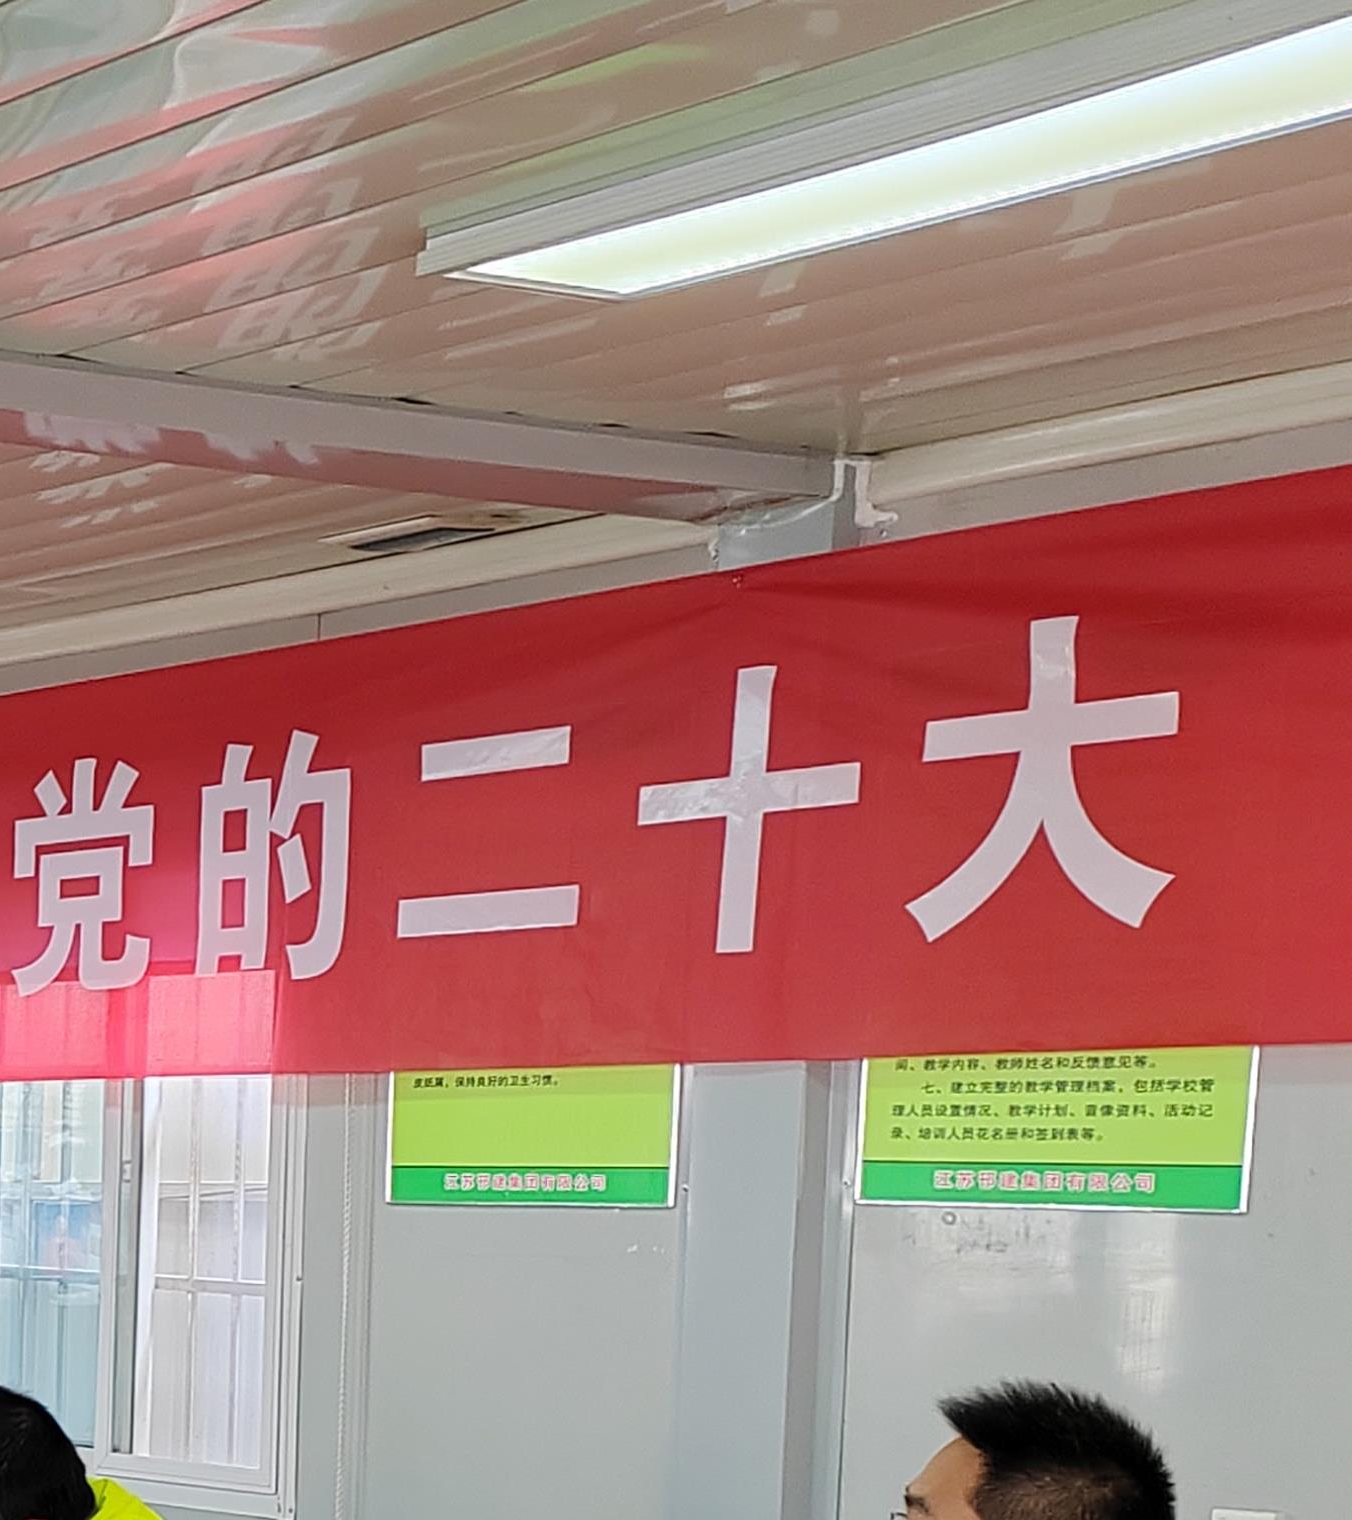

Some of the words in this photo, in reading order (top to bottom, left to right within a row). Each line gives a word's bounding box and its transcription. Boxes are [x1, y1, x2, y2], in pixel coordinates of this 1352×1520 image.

[933, 1169, 1156, 1193] 江苏邗建集团有限公司
